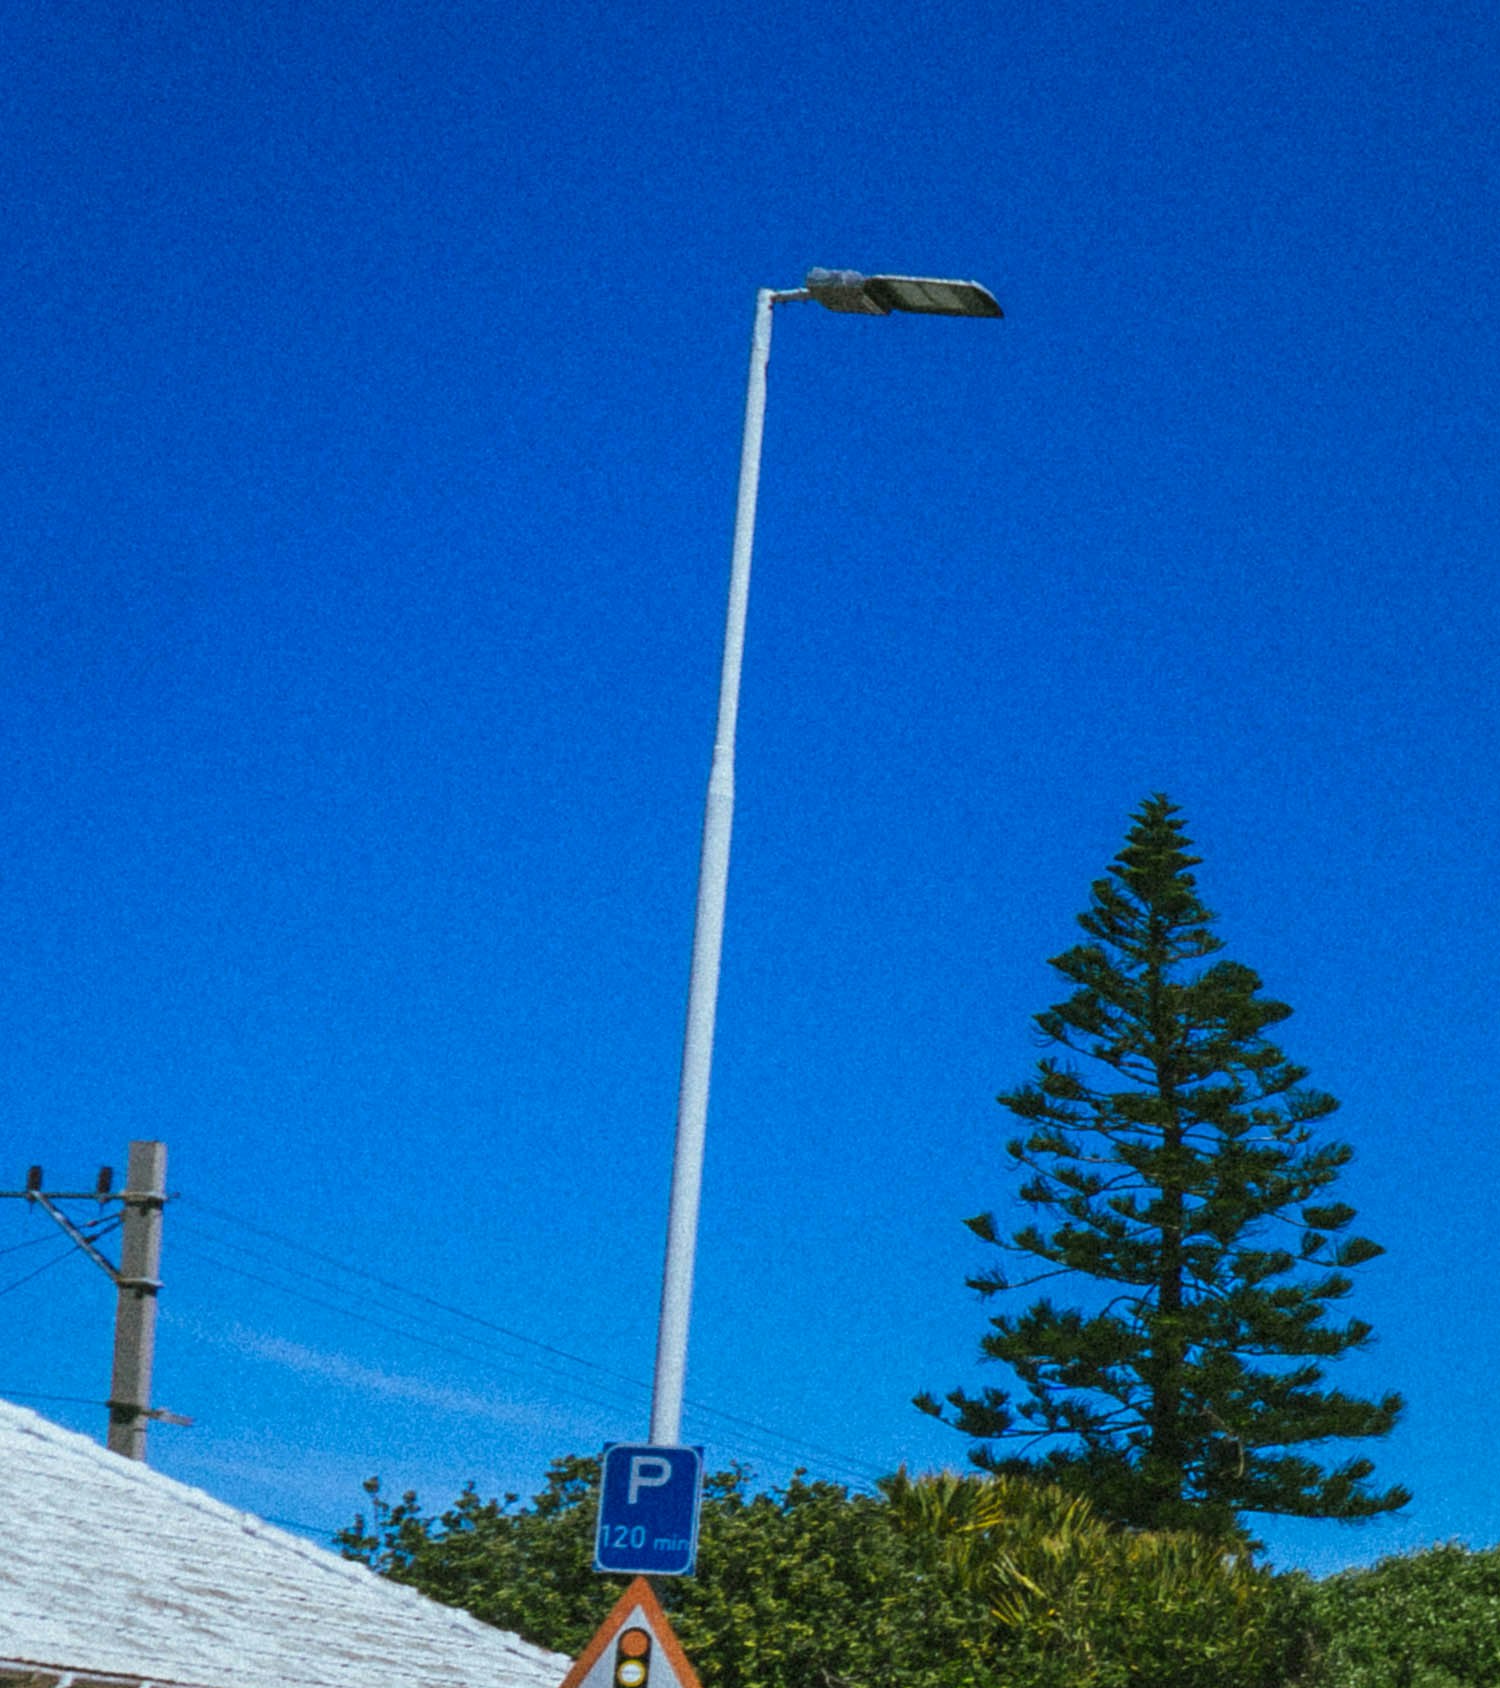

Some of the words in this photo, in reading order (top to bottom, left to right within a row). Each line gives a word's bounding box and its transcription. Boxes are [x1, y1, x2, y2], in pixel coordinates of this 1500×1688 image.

[627, 1456, 672, 1505] P
[601, 1524, 646, 1549] 120
[653, 1534, 690, 1552] min
